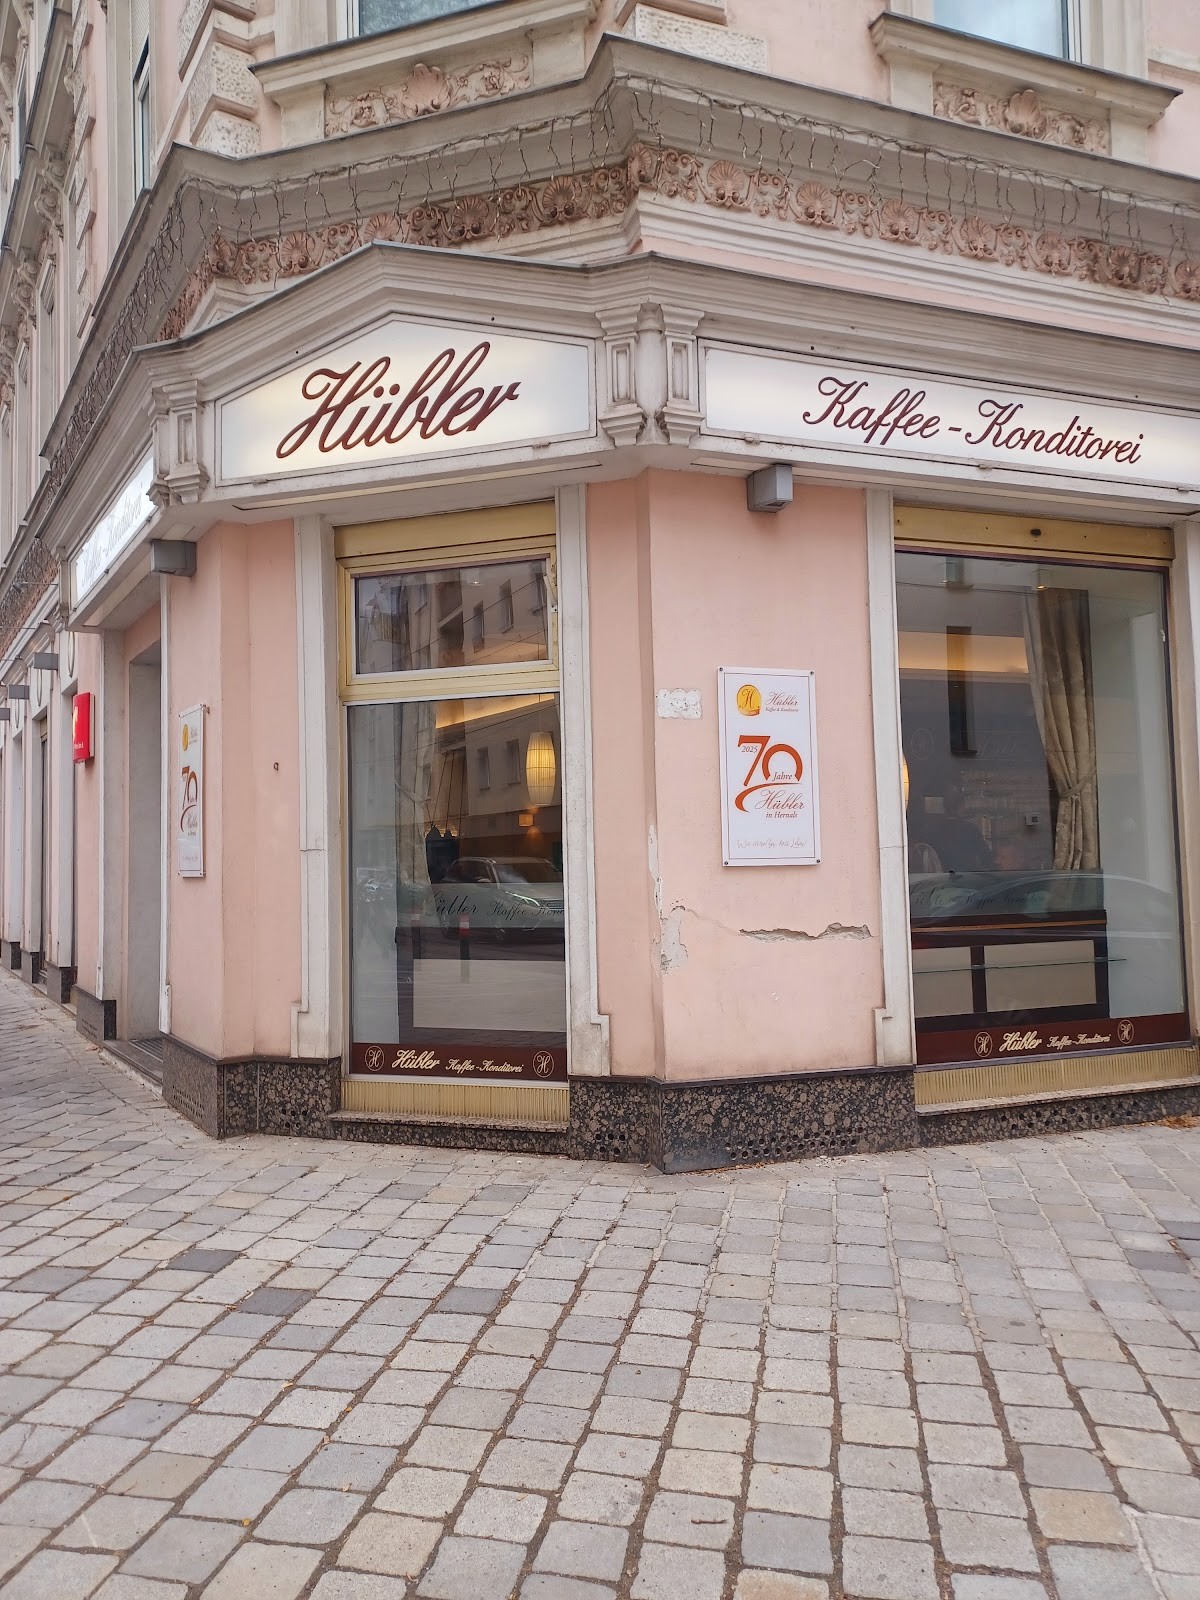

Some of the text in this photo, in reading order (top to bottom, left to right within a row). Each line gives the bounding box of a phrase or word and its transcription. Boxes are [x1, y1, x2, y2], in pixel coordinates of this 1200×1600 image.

[276, 341, 522, 459] Hübler
[802, 376, 941, 446] Kaffee
[764, 691, 799, 706] Hübler
[741, 745, 758, 753] 2025
[737, 734, 803, 786] 70
[772, 772, 793, 781] Jahre
[754, 789, 805, 810] Hübler
[774, 811, 798, 819] Hernals
[486, 900, 528, 921] Kaffee
[998, 1030, 1043, 1053] Hübler
[391, 1049, 441, 1070] Hübler
